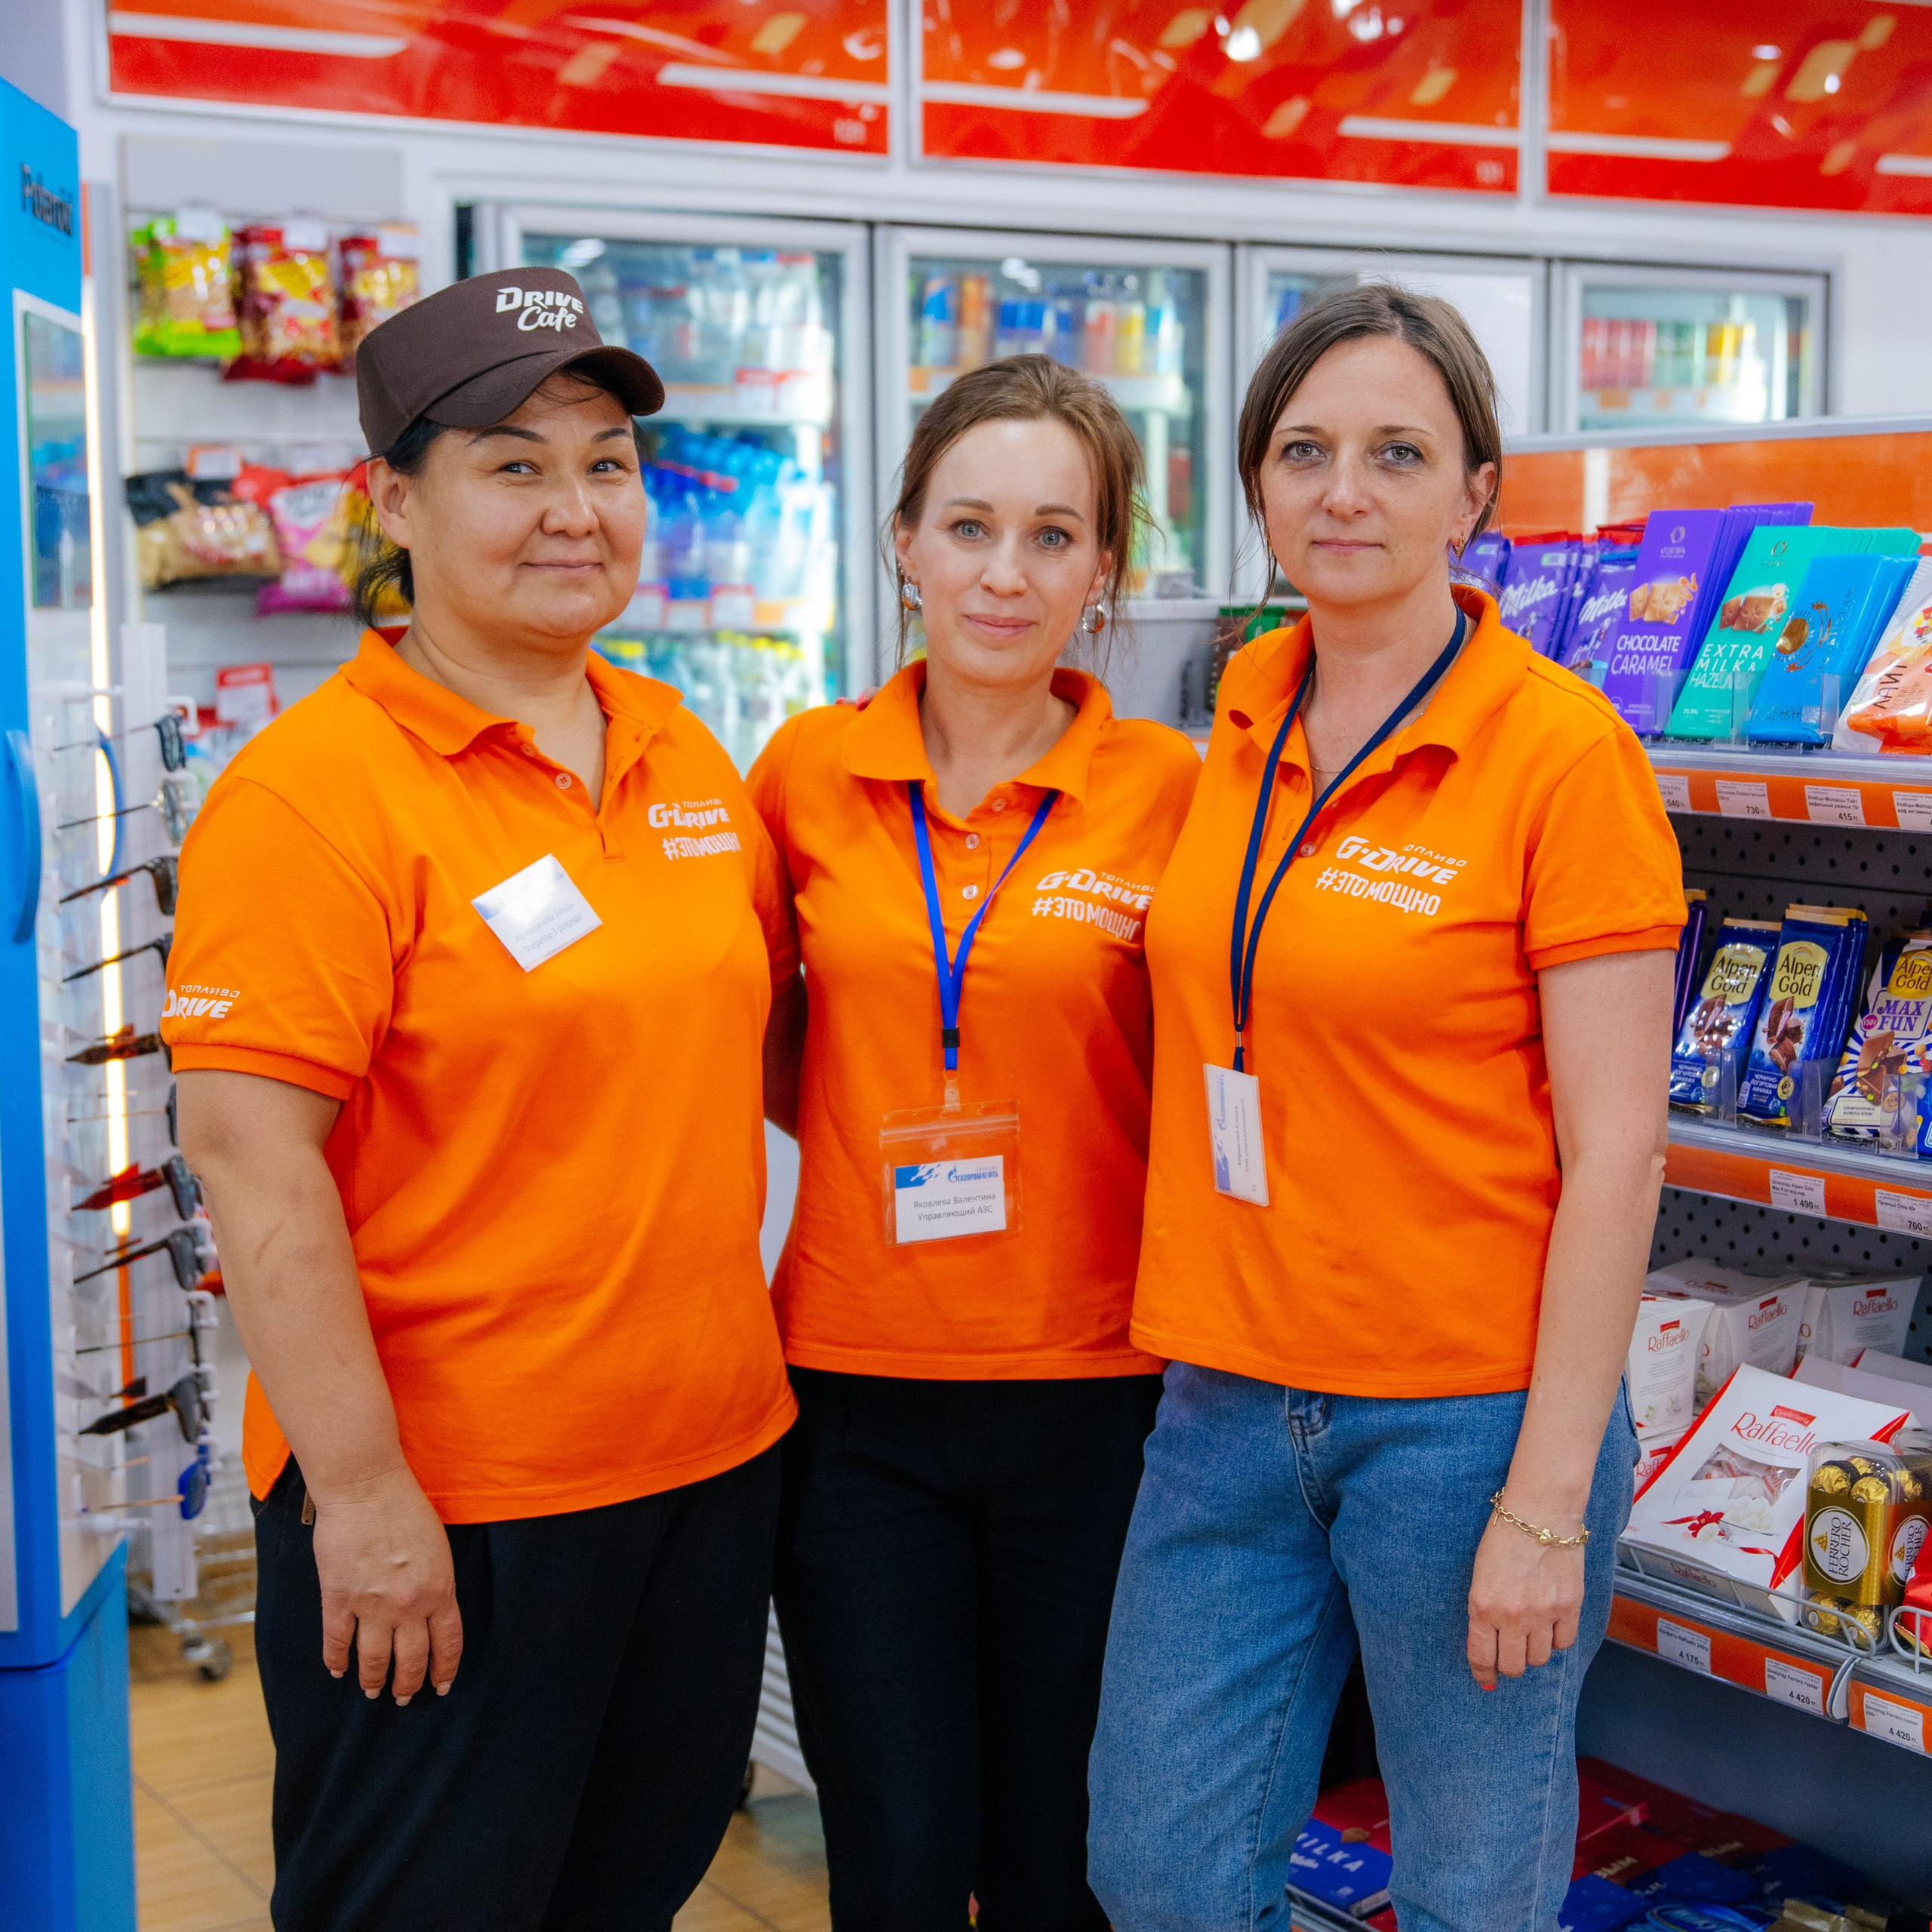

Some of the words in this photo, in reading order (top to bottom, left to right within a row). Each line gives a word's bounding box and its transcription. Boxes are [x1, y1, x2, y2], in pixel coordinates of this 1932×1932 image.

[496, 286, 584, 314] DRIVE
[517, 305, 577, 332] Cafe
[1499, 575, 1559, 620] Milka
[1578, 588, 1629, 626] Milk
[1616, 635, 1682, 654] CHOCOLATE
[1701, 643, 1764, 660] EXTRA
[1611, 654, 1673, 677] CARAMEL
[1694, 658, 1745, 672] MILK
[1747, 662, 1757, 672] &
[1687, 672, 1738, 691] HAZELN
[682, 798, 723, 808] ТОПЛИВ
[1666, 798, 1680, 808] 540
[1746, 805, 1760, 814] 730
[1838, 812, 1853, 821] 415
[1401, 844, 1468, 867] ОПЛИВО
[1315, 866, 1441, 916] #ЭТОМОЩНО
[522, 931, 554, 954] Оператор
[552, 928, 558, 936] 3
[558, 913, 583, 934] разряда
[1712, 955, 1757, 979] Alpen
[1778, 953, 1821, 980] Alpen
[1710, 975, 1749, 995] Gold
[1778, 975, 1813, 997] Gold
[1895, 974, 1931, 991] Gold
[1877, 998, 1927, 1017] MAX
[1878, 1015, 1919, 1032] FUN
[913, 1198, 951, 1209] Яковлева
[953, 1192, 996, 1204] Валентина
[1799, 1199, 1814, 1209] 490
[917, 1208, 975, 1222] Управляющий
[977, 1204, 993, 1214] АЗС
[1907, 1220, 1923, 1231] 700
[1748, 1302, 1788, 1331] Raffaello
[1853, 1298, 1900, 1317] Raffaello
[1647, 1327, 1690, 1353] Raffaello
[1828, 1516, 1842, 1574] FERRERO
[1838, 1520, 1853, 1577] ROCHER
[1913, 1523, 1923, 1564] CHER
[1685, 1653, 1700, 1665] 175
[1787, 1675, 1804, 1685] Ferrero
[1789, 1690, 1795, 1699] 4
[1796, 1693, 1810, 1705] 420
[1886, 1711, 1903, 1721] Ferrero
[1889, 1727, 1894, 1735] 4
[1896, 1730, 1911, 1742] 420
